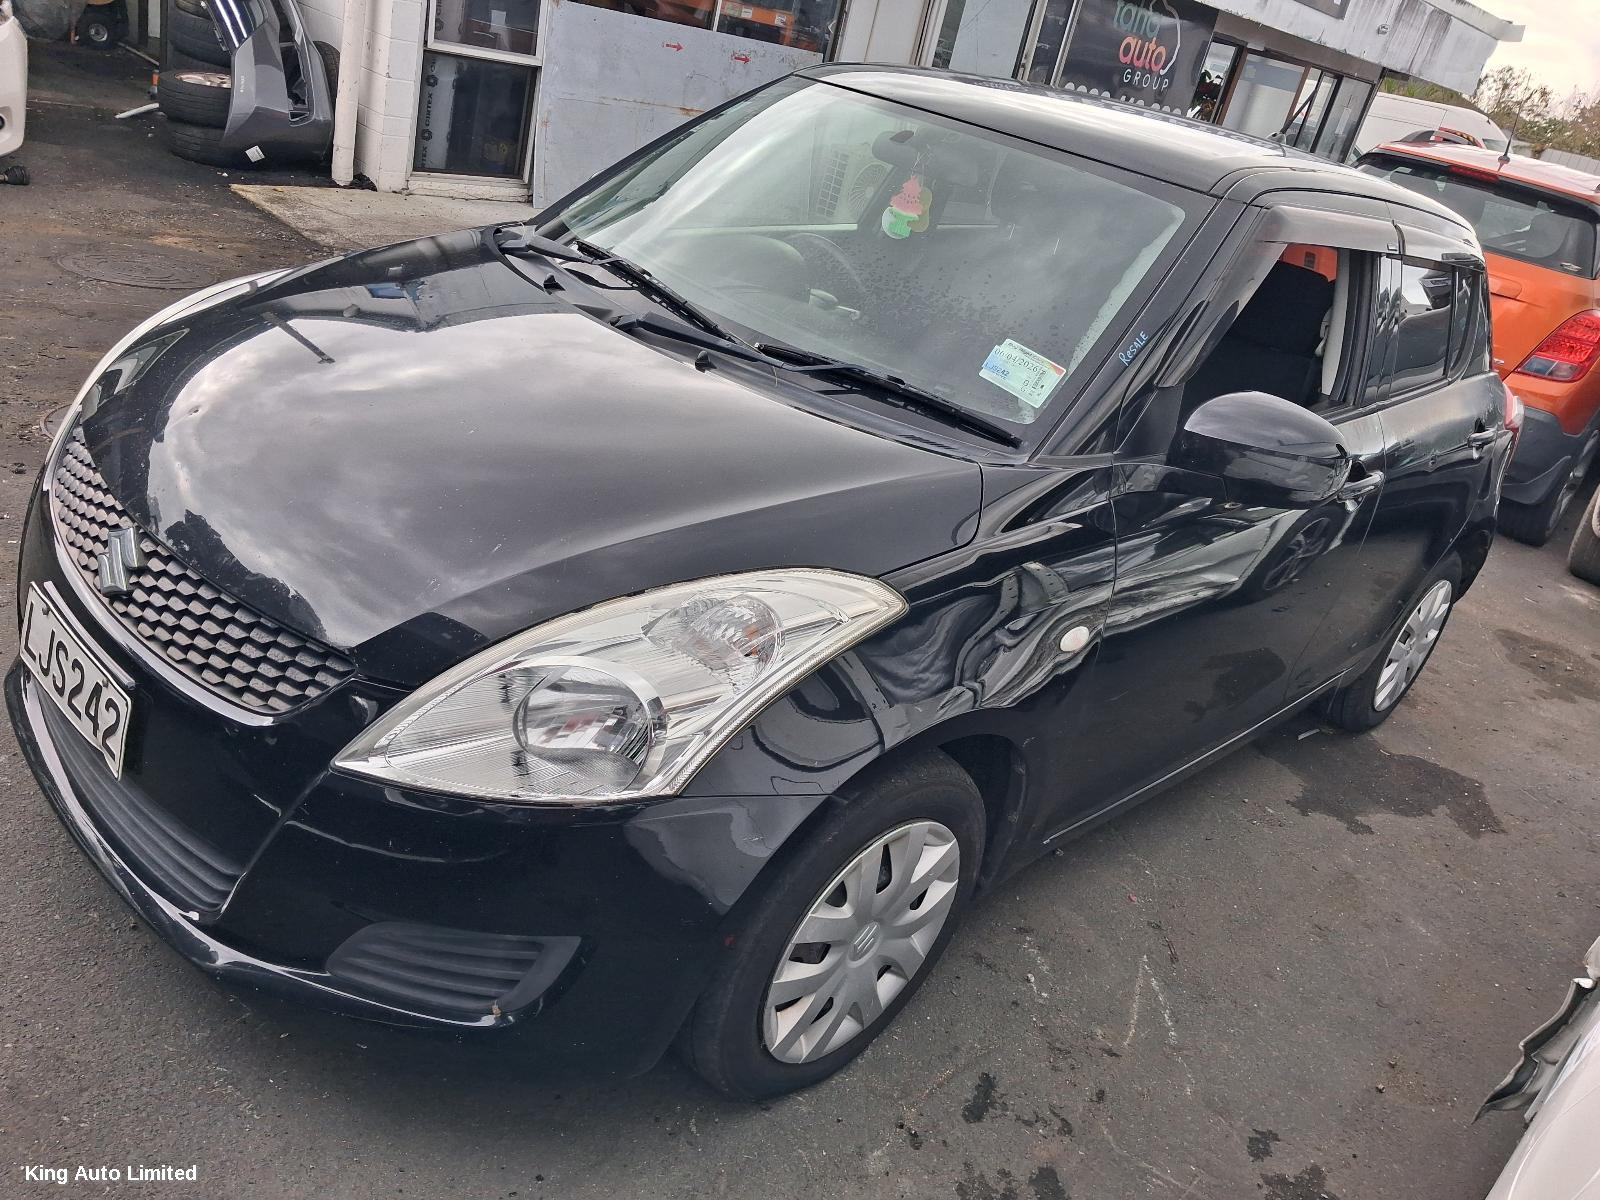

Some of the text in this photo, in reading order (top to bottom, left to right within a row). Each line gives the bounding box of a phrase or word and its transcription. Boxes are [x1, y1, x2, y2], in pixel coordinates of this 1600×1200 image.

[1119, 36, 1167, 72] auto
[1123, 68, 1169, 91] GROUP
[994, 348, 1038, 372] 06/04/2026
[24, 600, 121, 762] LJS242
